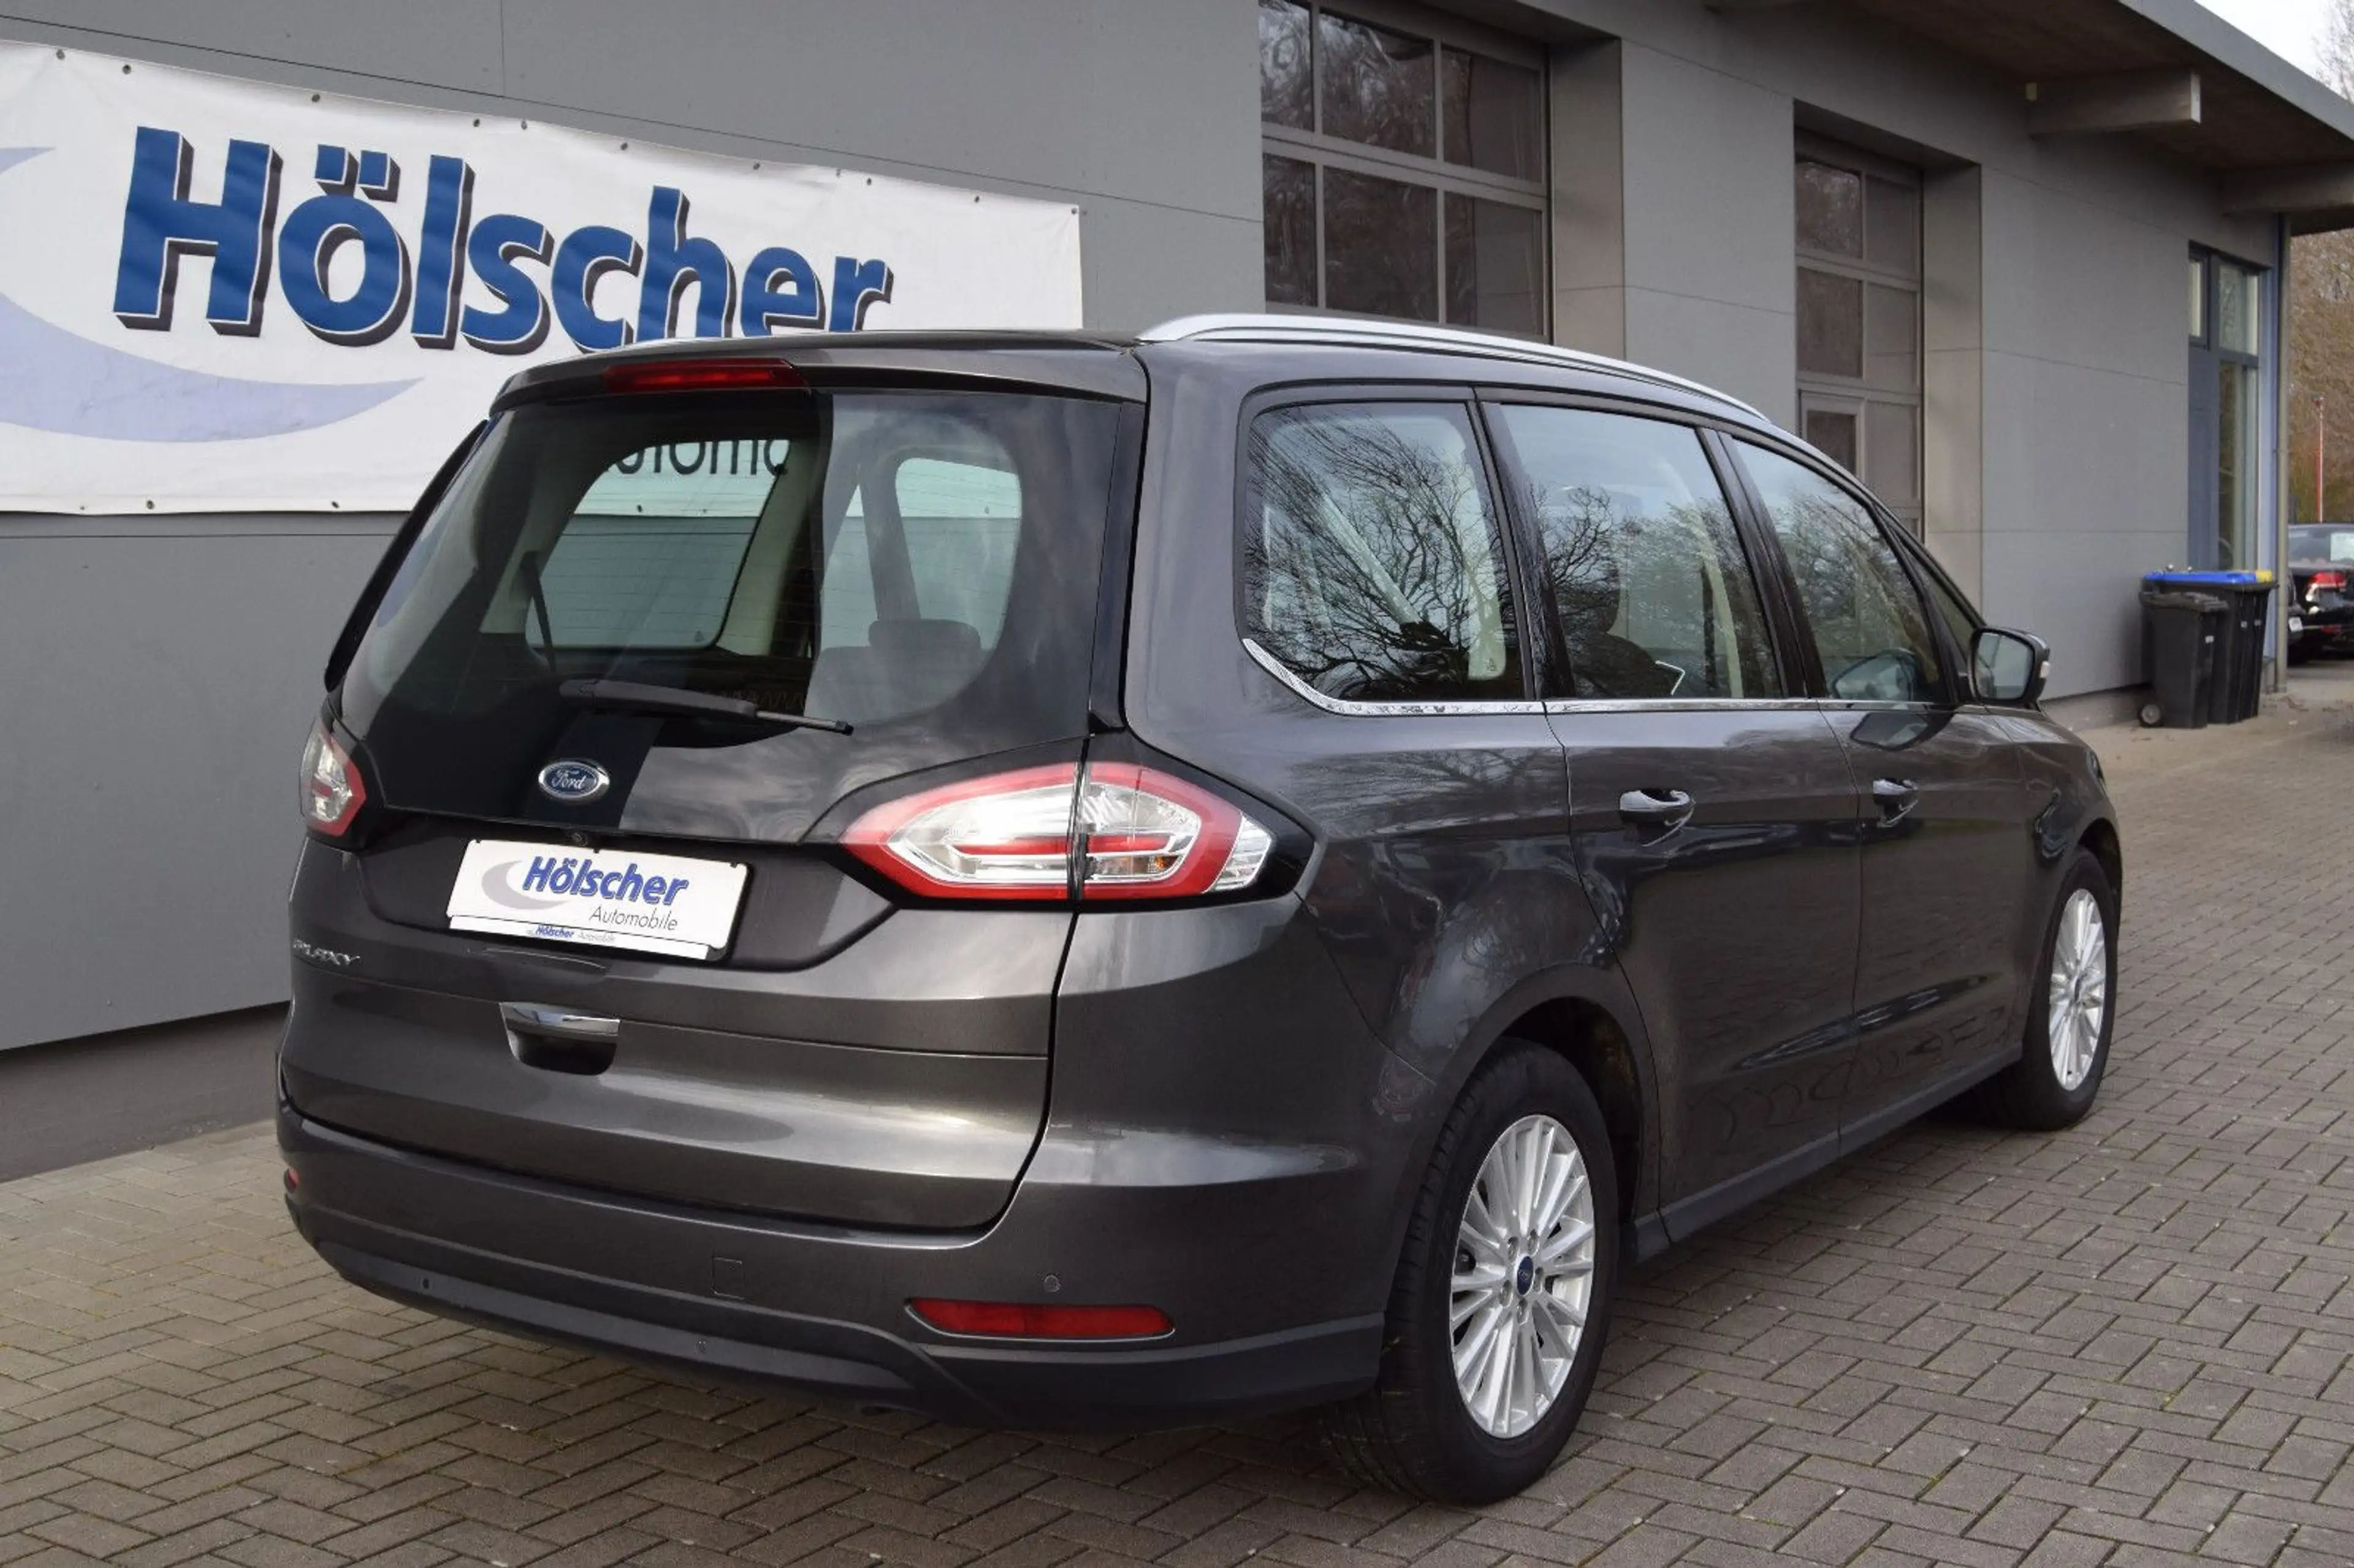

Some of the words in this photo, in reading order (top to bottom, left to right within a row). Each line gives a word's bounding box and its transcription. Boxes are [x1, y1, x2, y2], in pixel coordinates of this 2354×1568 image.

[113, 125, 894, 356] Hölscher
[551, 769, 587, 790] Ford
[521, 856, 690, 907] Hölscher
[588, 905, 679, 932] Automobile
